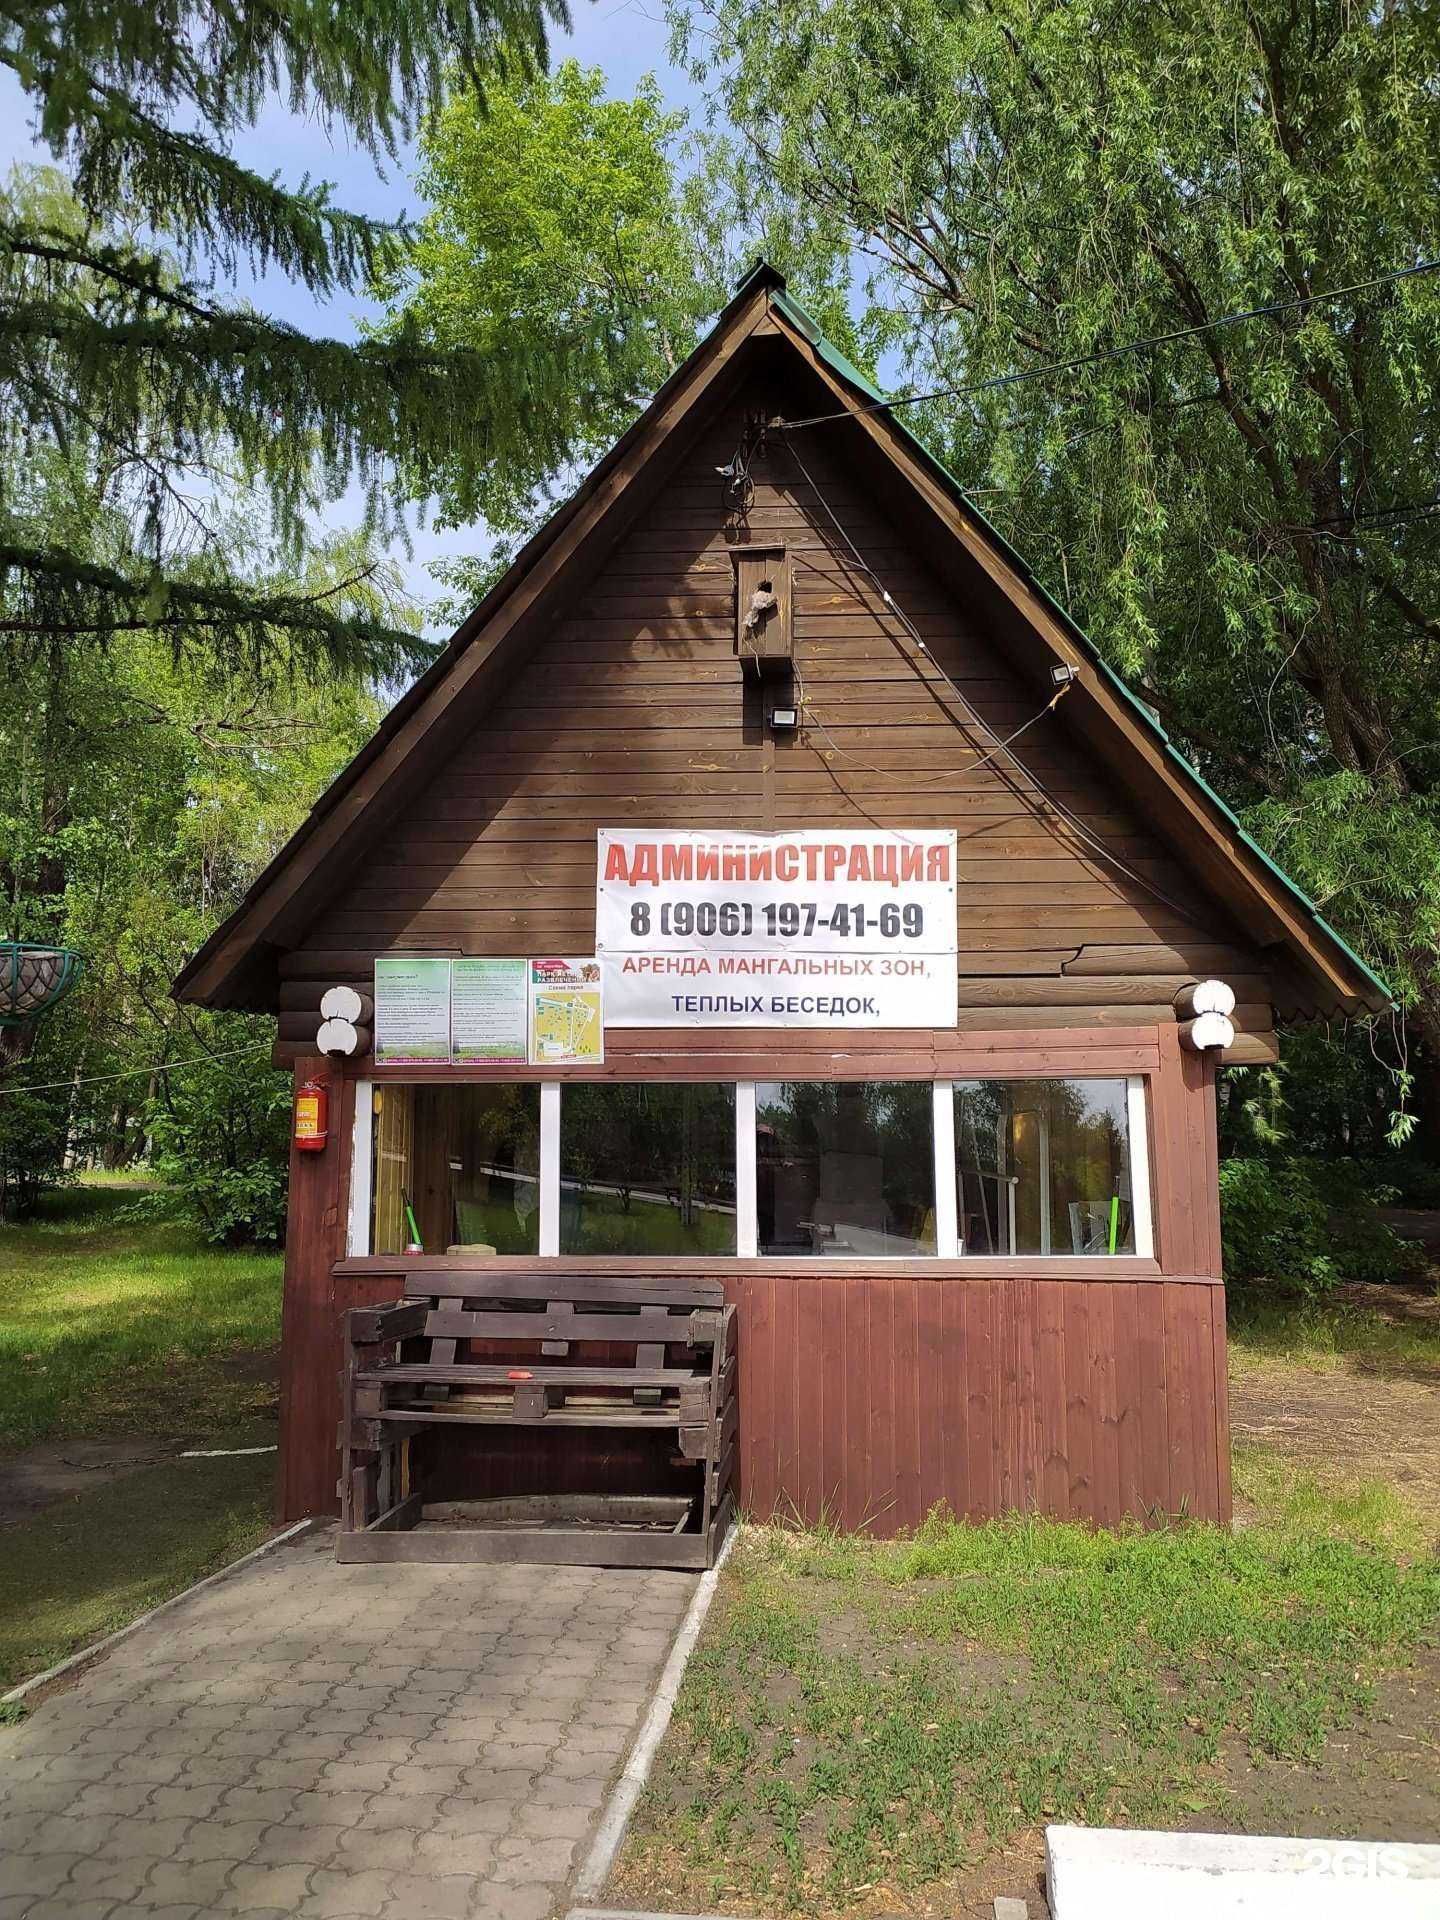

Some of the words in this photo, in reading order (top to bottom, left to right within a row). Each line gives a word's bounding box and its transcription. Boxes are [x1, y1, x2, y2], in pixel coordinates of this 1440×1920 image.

[604, 844, 950, 886] АДМИНИСТРАЦИЯ
[630, 902, 650, 936] 8
[661, 902, 753, 936] (906)
[762, 902, 923, 937] 197-41-69
[623, 957, 710, 976] АРЕНДА
[719, 958, 873, 975] МАНГАЛЬНЫХ
[881, 960, 931, 978] ЗОН,
[672, 995, 763, 1013] ТЕПЛЫХ
[771, 997, 880, 1016] БЕСЕДОК,
